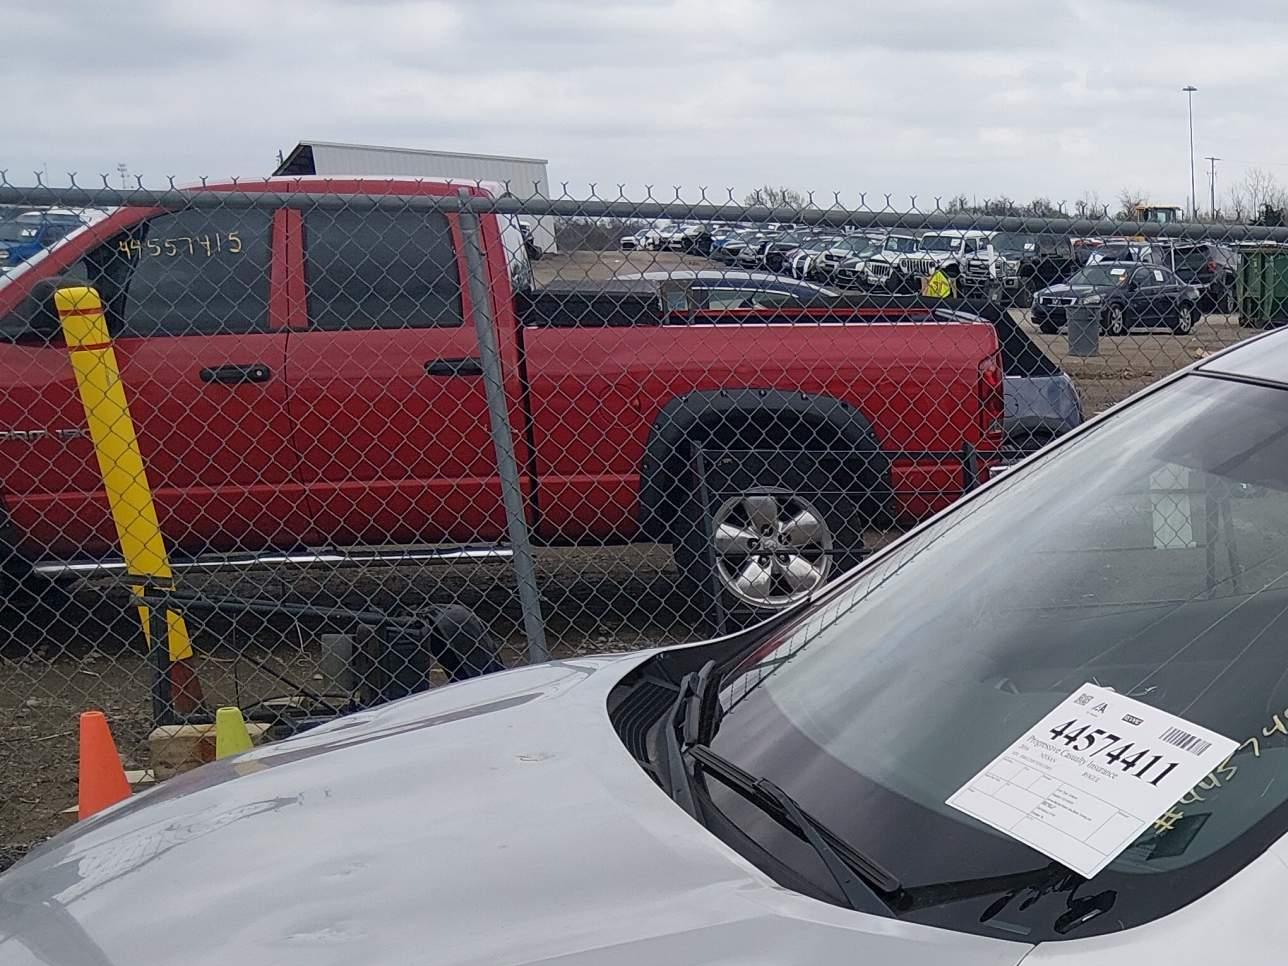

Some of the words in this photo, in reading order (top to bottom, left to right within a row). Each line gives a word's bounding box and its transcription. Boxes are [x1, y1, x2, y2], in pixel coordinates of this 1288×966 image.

[1026, 735, 1061, 754] Progressive
[1060, 748, 1086, 766] Casualty
[1086, 760, 1119, 779] Insurance
[1048, 718, 1181, 788] 44574411
